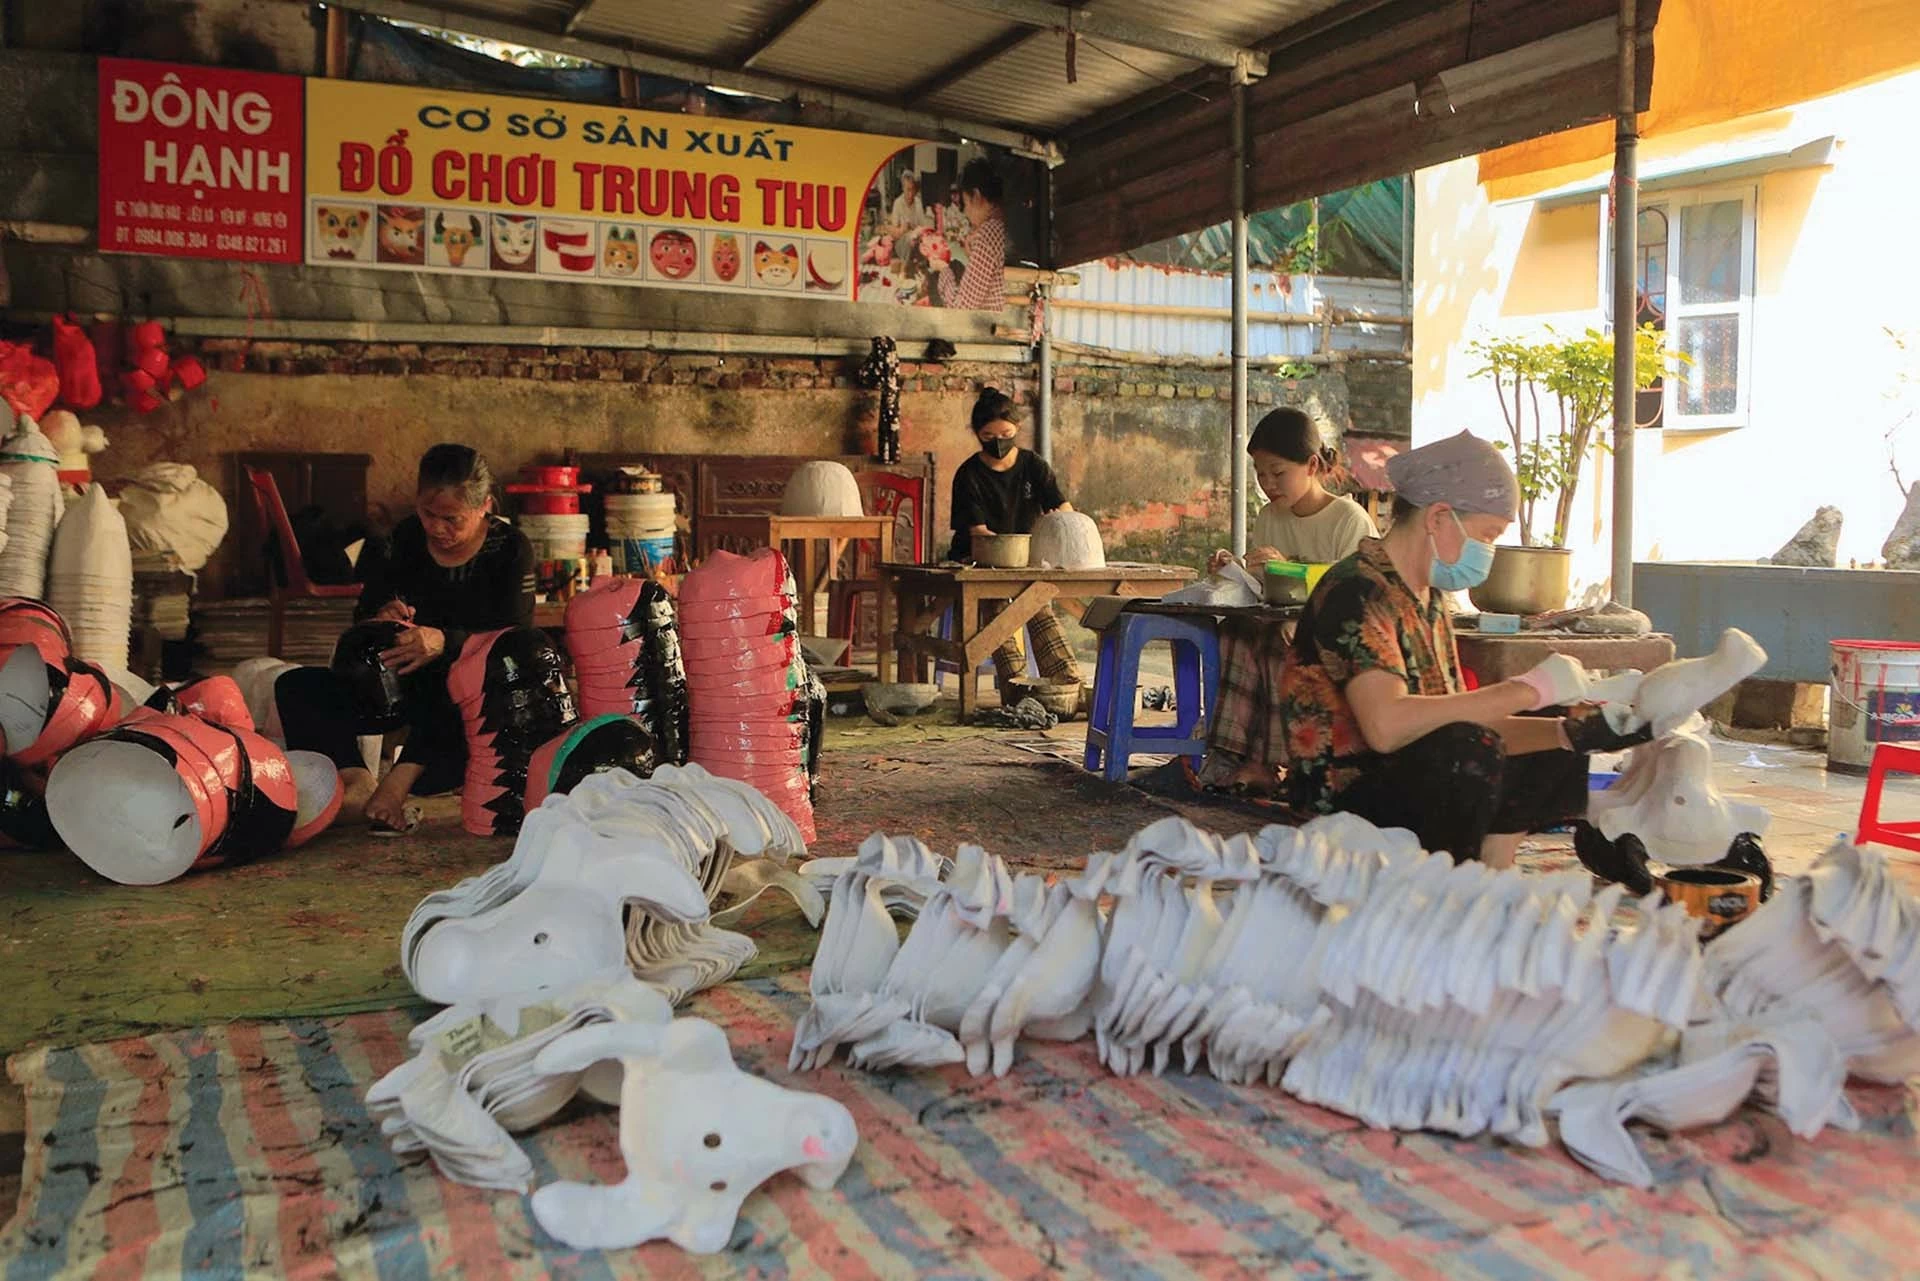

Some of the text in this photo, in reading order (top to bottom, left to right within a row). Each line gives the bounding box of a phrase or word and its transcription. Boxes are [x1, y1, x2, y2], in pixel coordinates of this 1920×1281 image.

[112, 73, 273, 135] ĐÔNG
[418, 105, 795, 162] CƠ SỞ SẢN XUẤT
[144, 140, 290, 199] HẠNH
[433, 149, 557, 208] CHƠI
[574, 162, 742, 222] TRUNG
[756, 178, 848, 232] THU
